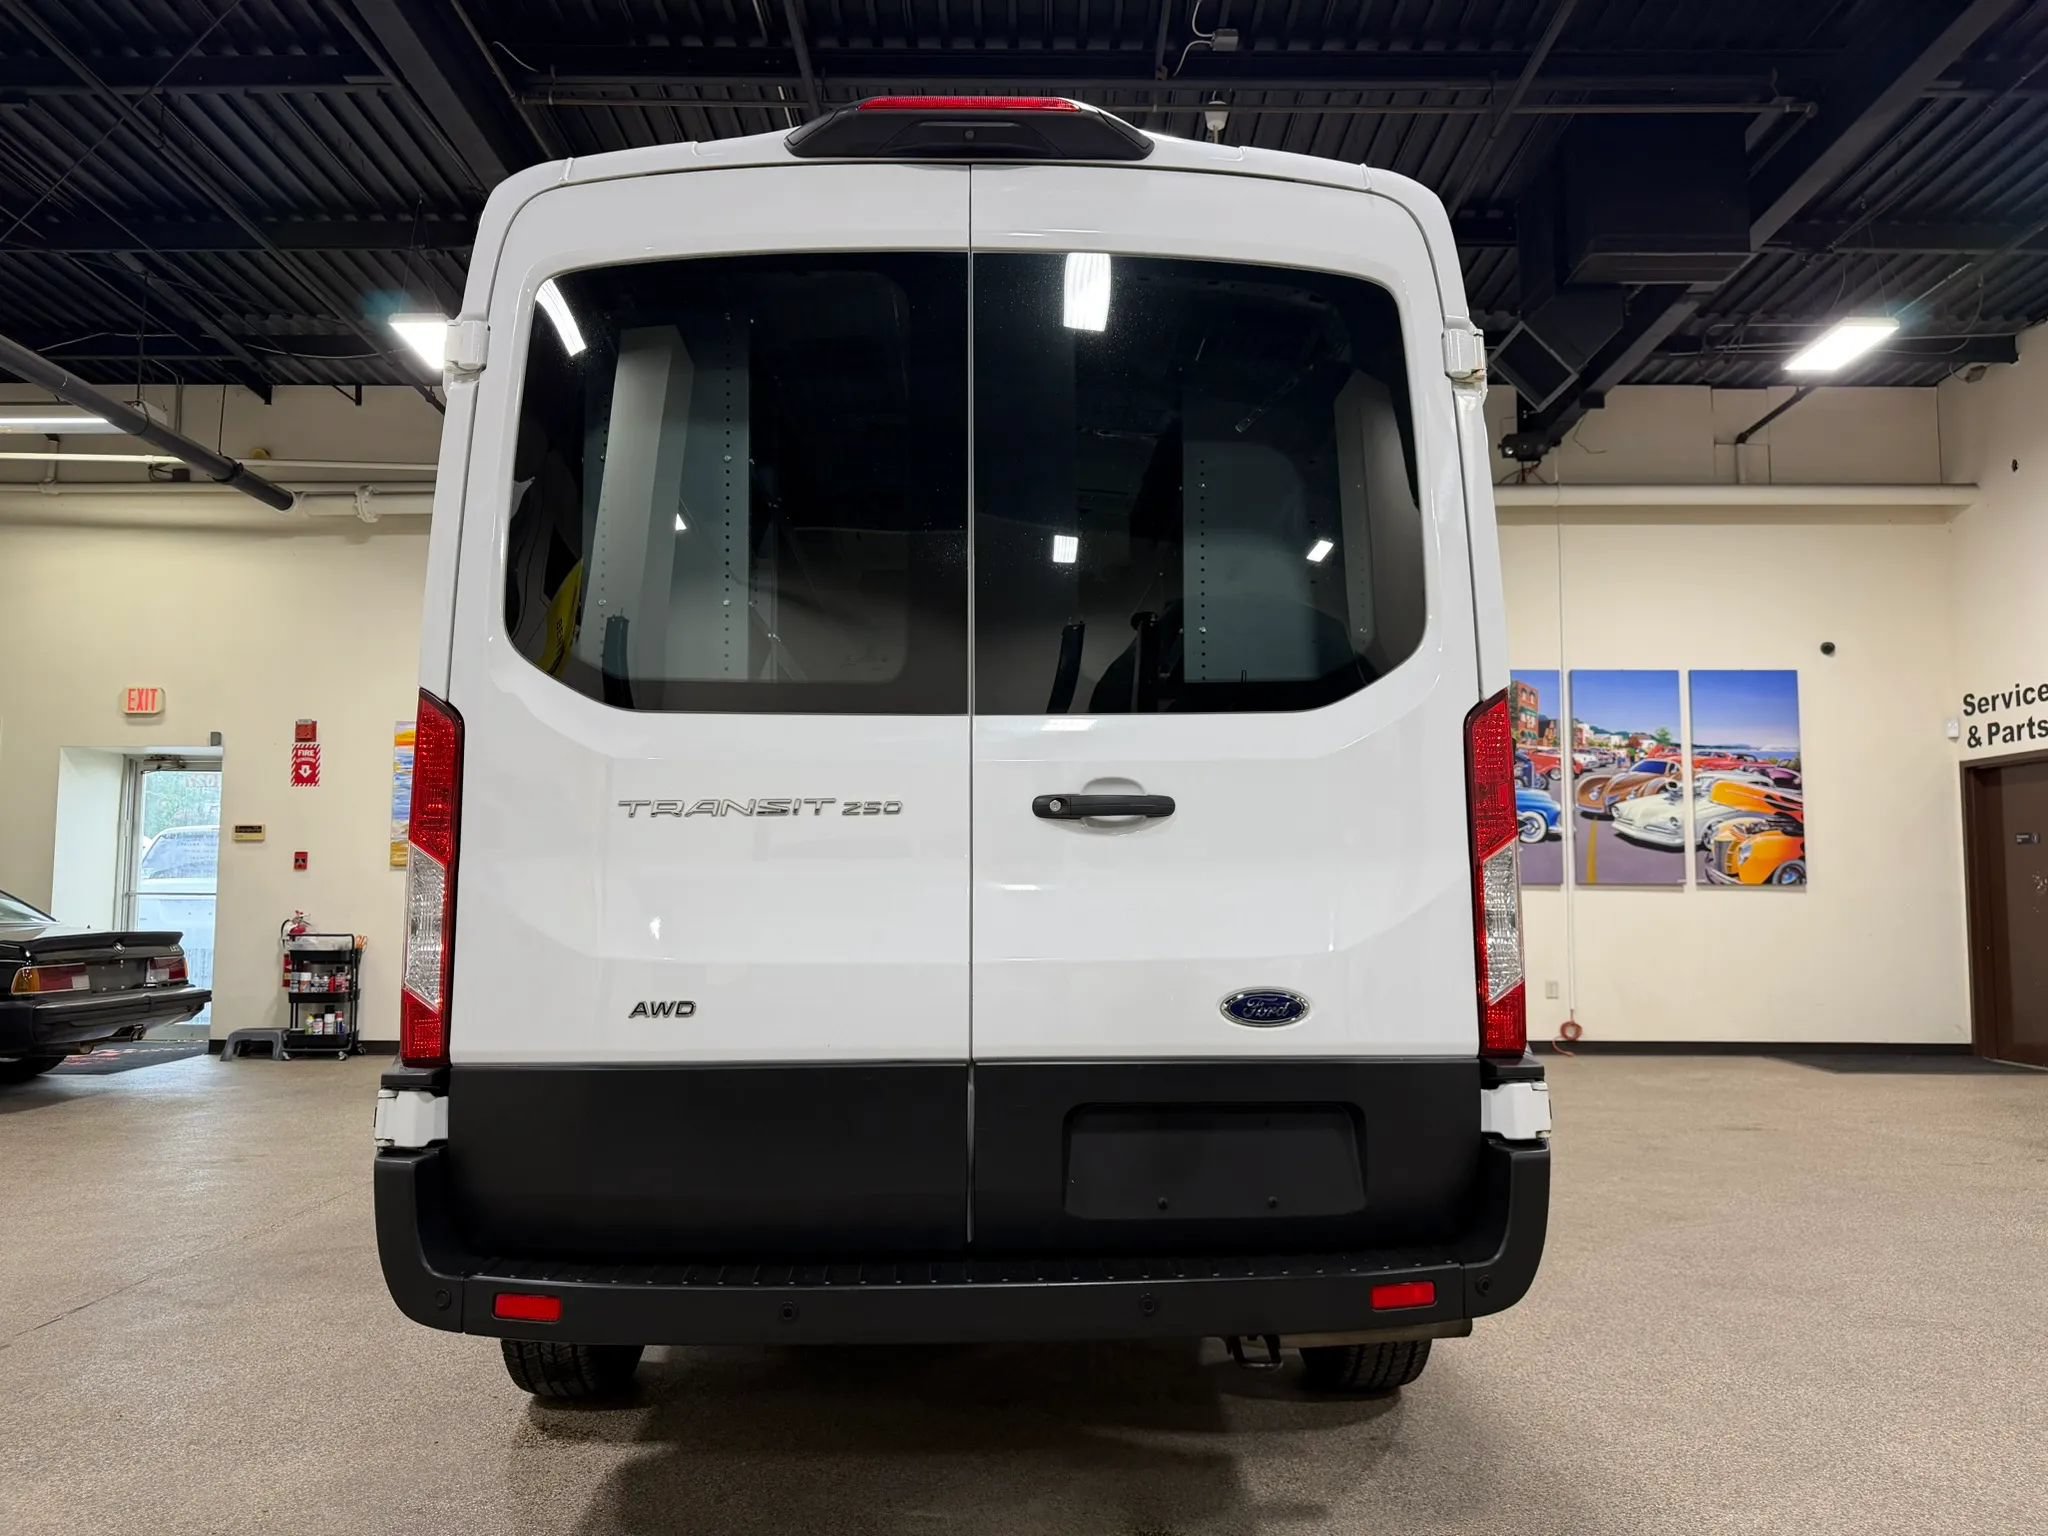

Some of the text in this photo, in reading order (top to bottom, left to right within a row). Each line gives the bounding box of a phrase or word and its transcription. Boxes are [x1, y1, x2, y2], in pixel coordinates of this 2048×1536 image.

[128, 688, 158, 712] EXIT
[1963, 683, 2048, 716] Service
[1967, 716, 2048, 748] & Parts
[297, 749, 315, 757] FIRE
[618, 798, 903, 818] TRANSIT 250
[628, 1001, 696, 1019] AWD
